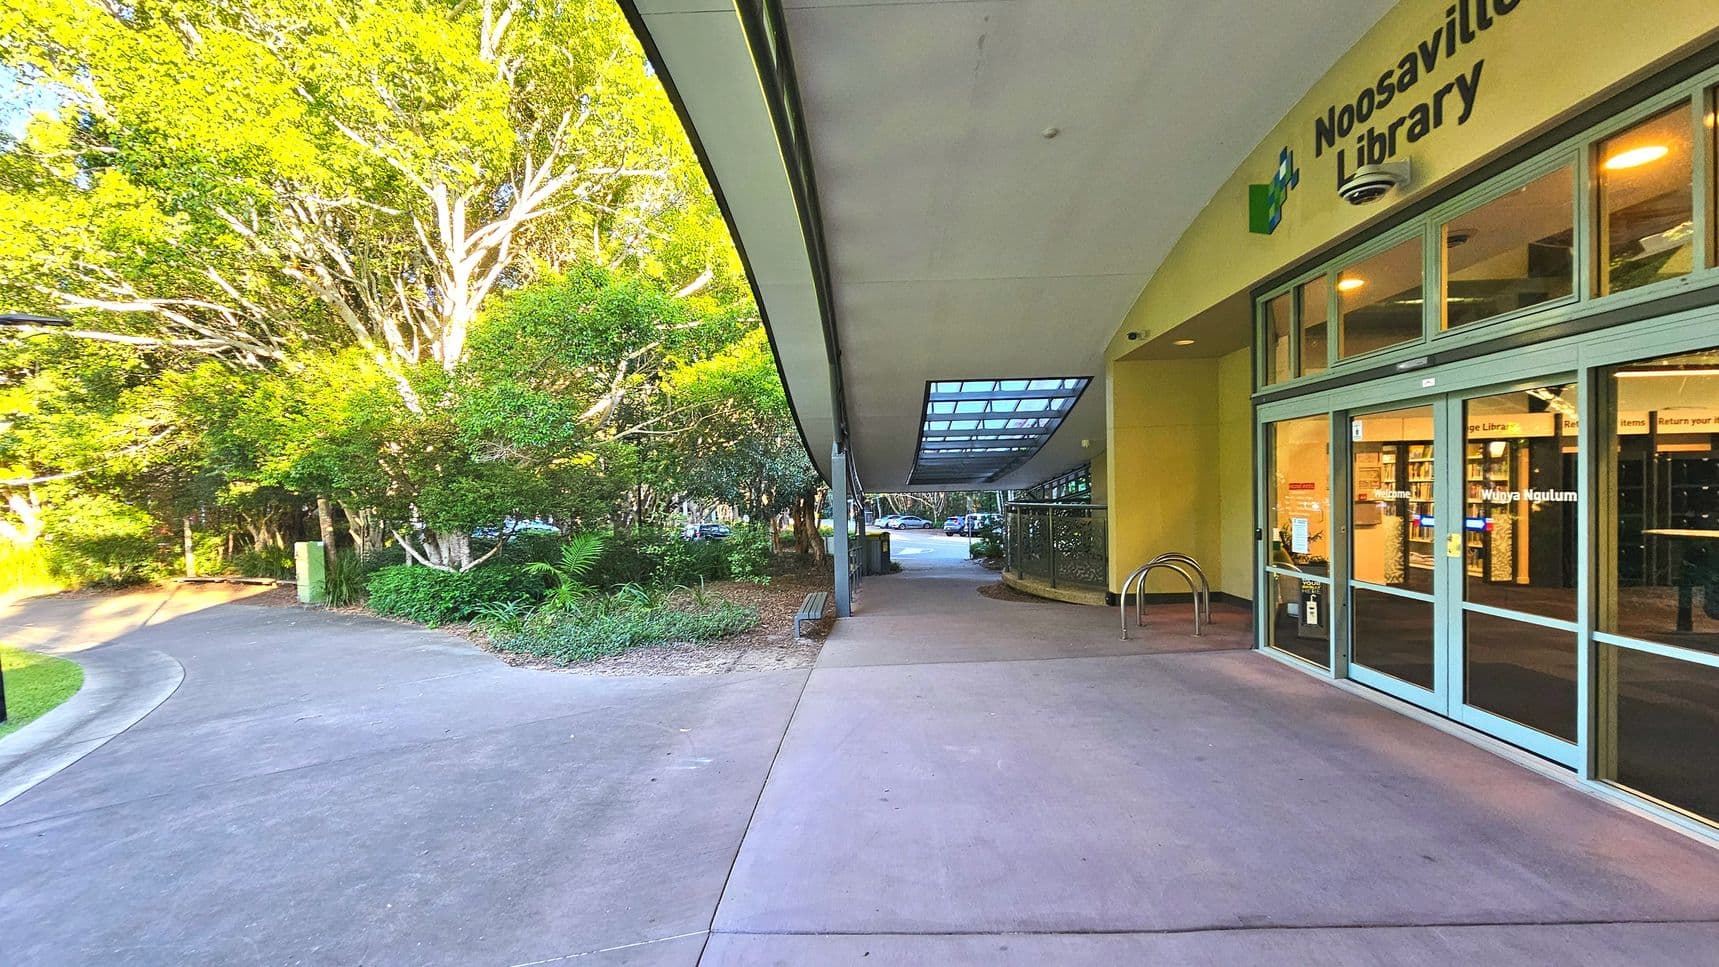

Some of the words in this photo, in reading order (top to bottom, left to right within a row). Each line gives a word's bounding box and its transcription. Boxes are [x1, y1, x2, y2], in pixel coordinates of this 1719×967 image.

[1337, 59, 1485, 191] Library
[1620, 418, 1646, 427] items
[1658, 417, 1689, 425] Return
[1691, 417, 1712, 426] your
[1374, 489, 1412, 499] Welcome
[1523, 488, 1578, 503] Ngulum
